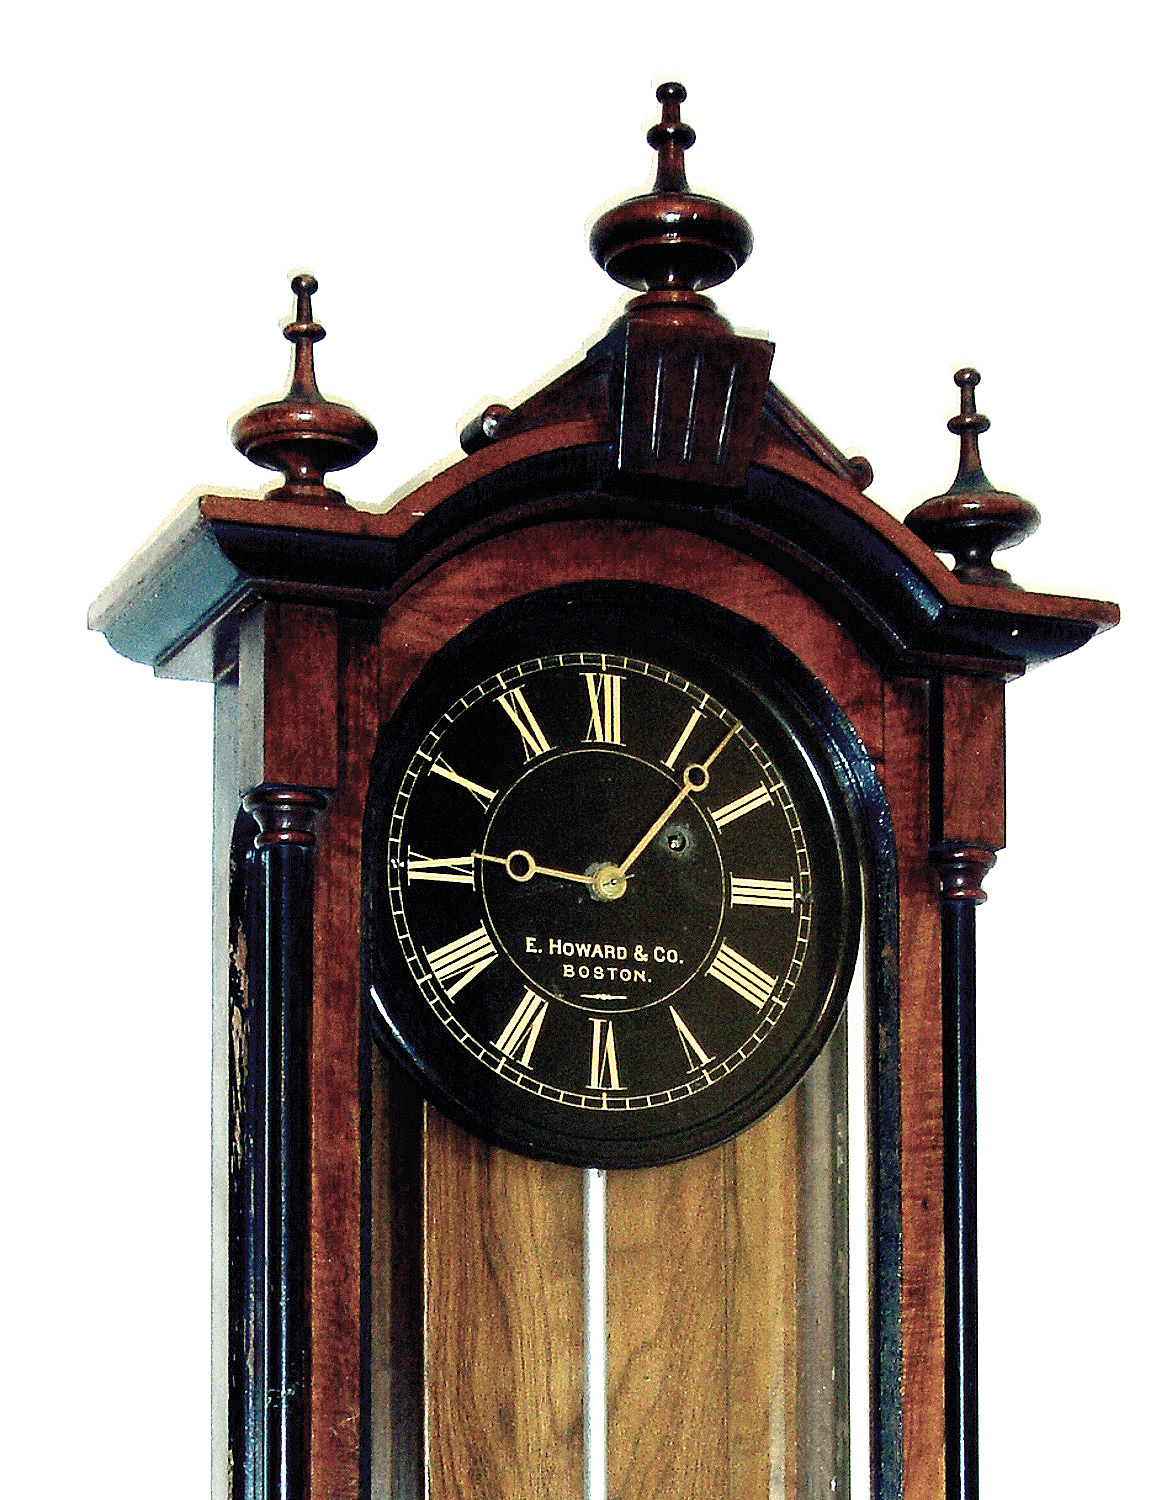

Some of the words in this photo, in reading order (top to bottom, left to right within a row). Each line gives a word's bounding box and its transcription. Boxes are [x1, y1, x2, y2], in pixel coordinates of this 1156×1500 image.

[494, 684, 558, 765] XI
[579, 672, 627, 746] XII
[660, 706, 707, 771] I
[428, 752, 500, 814] X
[707, 780, 775, 834] II
[407, 845, 476, 891] IX
[730, 872, 796, 913] III
[422, 919, 499, 1004] VIII
[525, 937, 543, 955] E.
[548, 938, 628, 961] HOWARD
[634, 945, 649, 962] &
[653, 946, 684, 964] CO.
[563, 964, 653, 983] BOSTON.
[704, 939, 778, 1013] IIII
[490, 985, 548, 1069] VII
[586, 1017, 628, 1090] VI
[669, 1005, 717, 1074] V
